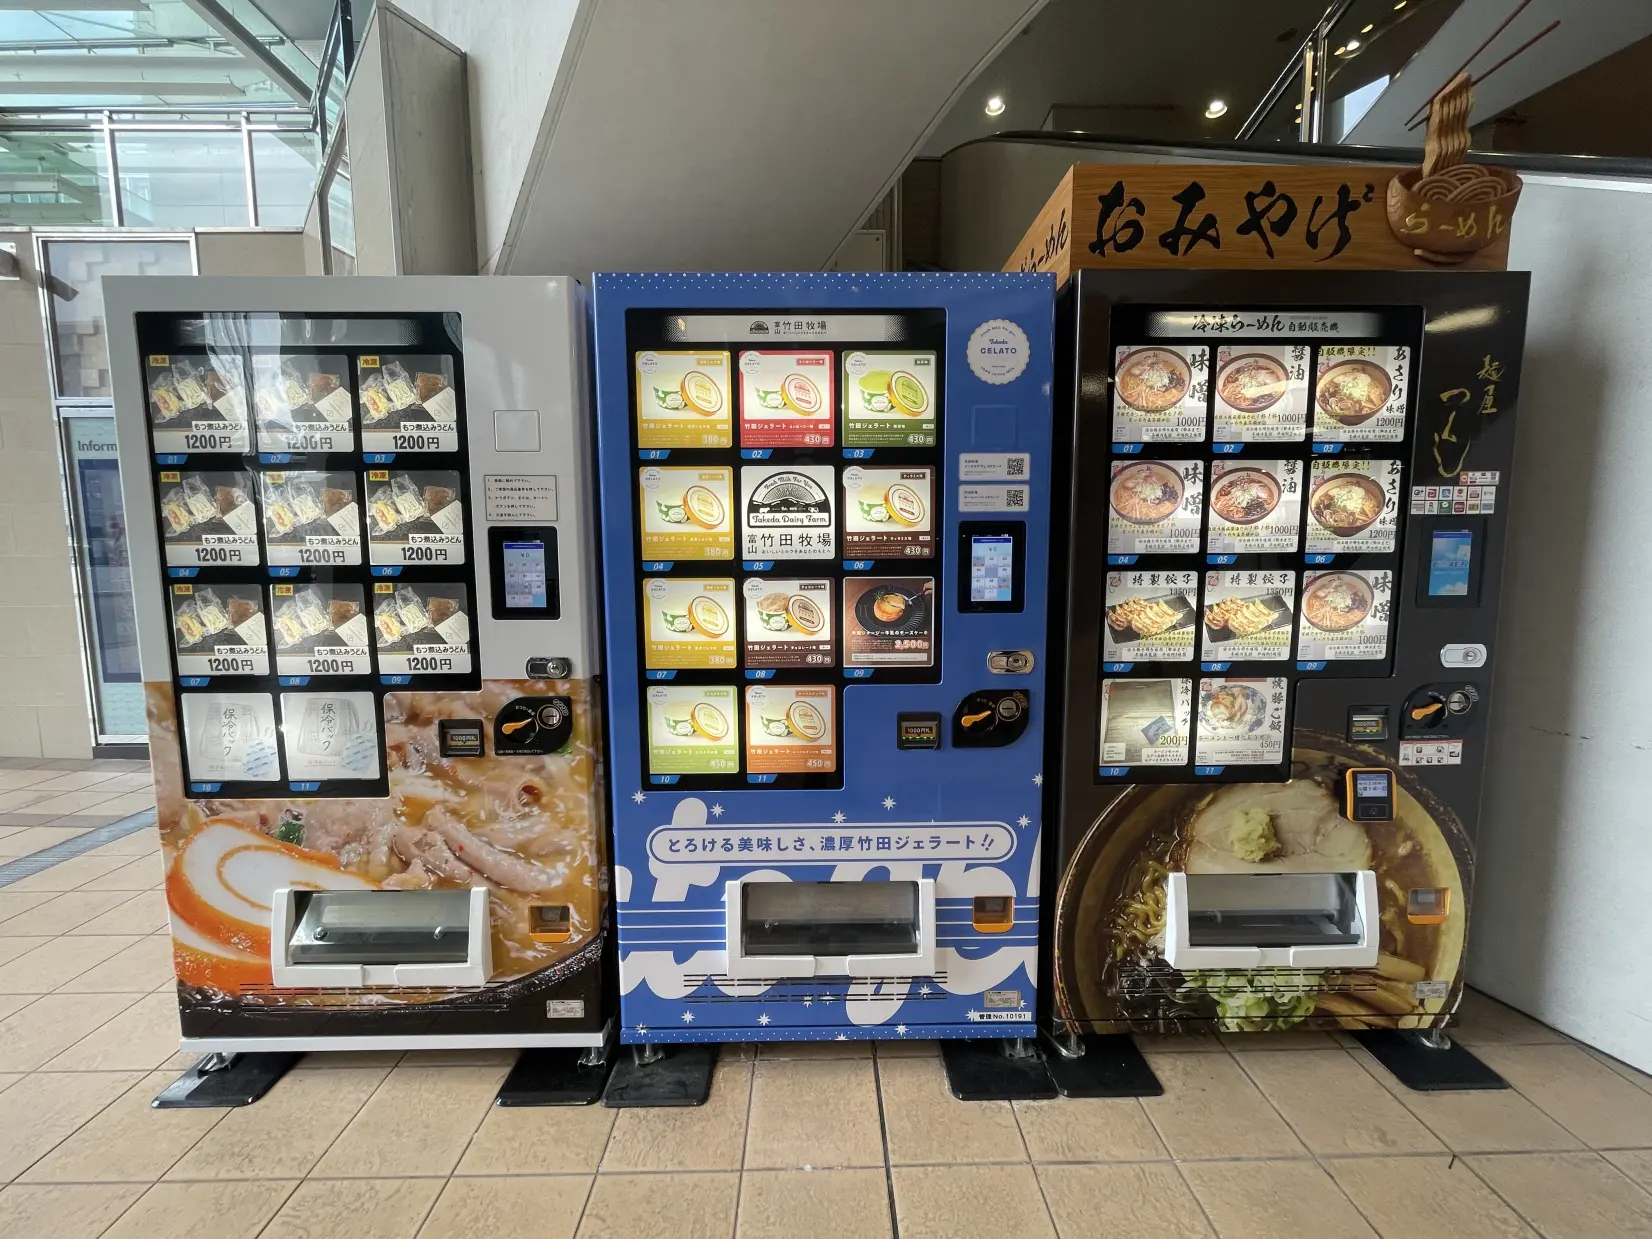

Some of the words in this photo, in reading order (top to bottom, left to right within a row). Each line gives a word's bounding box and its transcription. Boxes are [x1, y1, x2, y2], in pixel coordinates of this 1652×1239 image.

[1089, 180, 1374, 262] おみやげ
[1400, 203, 1505, 239] らーめん
[782, 320, 827, 330] 竹田牧場
[1191, 313, 1285, 333] 冷凍らーめん
[1288, 321, 1340, 333] 自動販売機
[362, 358, 378, 366] 冷凍
[402, 423, 454, 431] もつ煮込みうどん
[1375, 418, 1404, 428] 1200円
[184, 434, 232, 449] 1200円
[393, 435, 440, 450] 1200円
[804, 434, 829, 444] 430円
[907, 434, 933, 444] 430円
[1123, 445, 1134, 453] 01
[1223, 445, 1235, 453] 02
[374, 454, 385, 462] 03
[650, 451, 660, 459] 01
[751, 450, 763, 458] 02
[853, 450, 865, 458] 03
[371, 471, 387, 479] 冷凍
[752, 514, 780, 523] Takeda
[781, 514, 804, 525] Dairy
[805, 514, 828, 523] Farm
[1270, 525, 1298, 535] 1000円
[204, 537, 255, 545] もつ煮込みうどん
[307, 537, 359, 546] もつ煮込みうどん
[411, 536, 462, 544] もつ煮込みうどん
[747, 534, 757, 554] 富山
[760, 532, 832, 548] 竹田牧場
[195, 547, 242, 562] 1200円
[401, 547, 448, 561] 1200円
[904, 546, 930, 556] 430円
[298, 548, 346, 563] 1200円
[1315, 555, 1326, 563] 06
[1118, 556, 1129, 564] 04
[1217, 556, 1228, 564] 05
[653, 562, 664, 571] 04
[753, 562, 764, 570] 05
[853, 561, 864, 570] 06
[179, 568, 190, 576] 04
[279, 568, 290, 576] 05
[381, 567, 392, 575] 06
[1132, 573, 1193, 586] 特製餃子
[1230, 572, 1290, 586] 特製餃子
[376, 583, 391, 591] 冷凍
[1169, 588, 1197, 597] 1350円
[1266, 587, 1293, 597] 1350円
[316, 648, 367, 656] もつ煮込みうどん
[415, 646, 466, 654] もつ煮込みうどん
[806, 654, 831, 664] 430円
[208, 658, 254, 672] 1200円
[307, 659, 354, 673] 1200円
[406, 658, 452, 671] 1200円
[1211, 663, 1222, 671] 08
[656, 671, 668, 679] 07
[755, 670, 766, 678] 08
[854, 669, 865, 677] 09
[289, 677, 300, 685] 08
[391, 676, 402, 684] 09
[1160, 735, 1188, 746] 200円
[1110, 768, 1120, 776] 10
[1205, 767, 1215, 775] 11
[661, 775, 670, 783] 10
